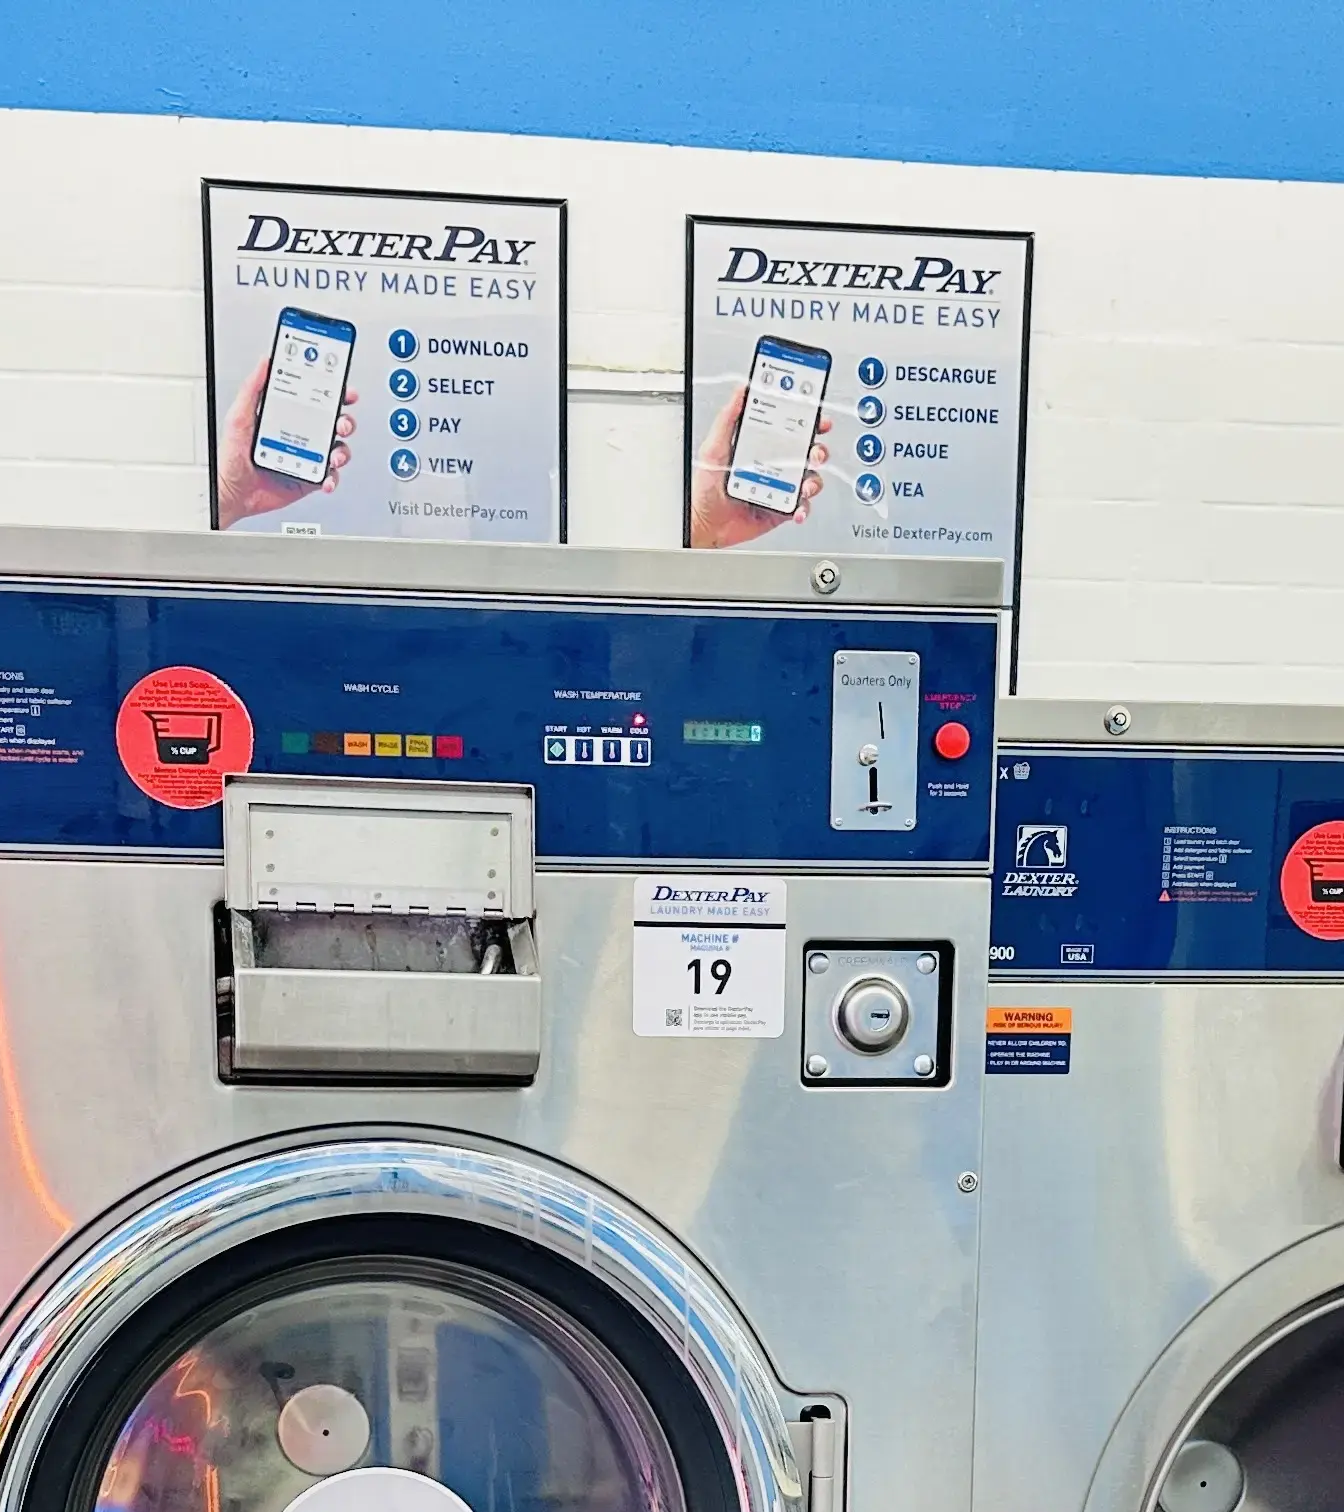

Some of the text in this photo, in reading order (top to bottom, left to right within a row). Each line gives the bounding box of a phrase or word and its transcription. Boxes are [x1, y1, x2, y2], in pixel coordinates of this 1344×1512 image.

[237, 264, 536, 300] LAUNDRY MADE EASY
[716, 296, 1000, 329] LAUNDRY MADE EASY
[397, 335, 528, 358] 1 DOWNLOAD
[866, 363, 997, 385] 1 DESCARGUE
[398, 375, 495, 395] 2 SELECT
[865, 402, 999, 424] 2 SELECCIONE
[398, 415, 460, 434] 3 PAY
[864, 440, 949, 459] 3 PAGUE
[398, 454, 473, 474] 4 VIEW
[862, 481, 924, 497] 4 VEA
[389, 502, 528, 520] Visit DexterPay.com
[853, 524, 993, 543] Visite DexterPay.com
[344, 684, 400, 693] WASH CYCLE
[841, 674, 911, 688] Quarters Only
[554, 690, 641, 700] WASH TEMPERATURE
[180, 747, 197, 755] CUP
[1004, 872, 1076, 884] DEXTER
[1002, 886, 1077, 896] LAUNDRY
[650, 906, 770, 916] LAUNDRY MADE EASY
[682, 934, 739, 943] MACHINE #
[1068, 953, 1086, 961] USA
[687, 959, 732, 994] 19
[1004, 1012, 1053, 1021] WARNING
